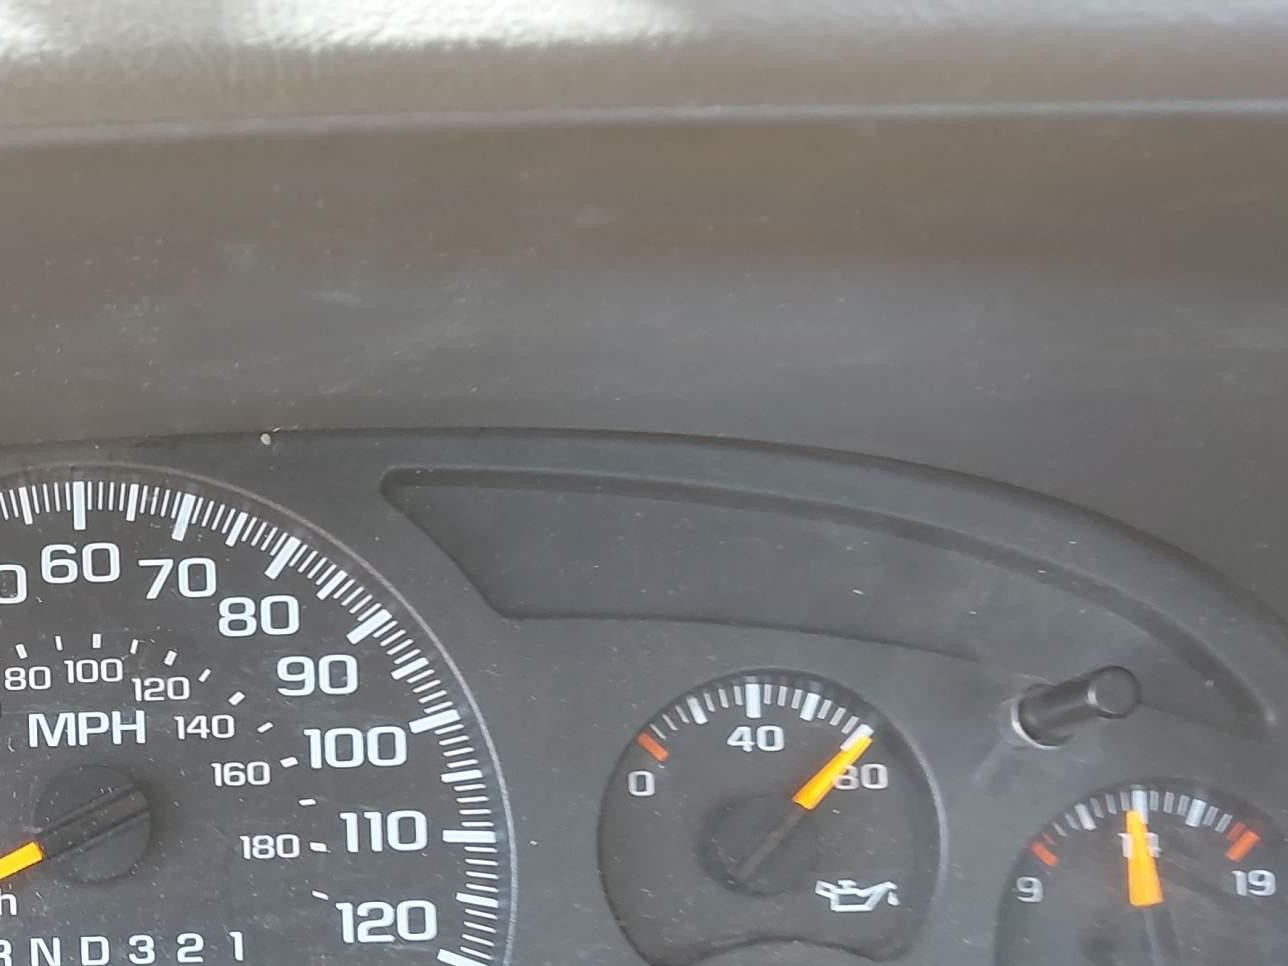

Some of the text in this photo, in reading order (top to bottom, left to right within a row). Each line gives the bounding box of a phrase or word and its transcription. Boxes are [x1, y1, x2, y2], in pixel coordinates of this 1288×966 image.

[41, 542, 121, 584] 60
[138, 557, 217, 600] 70
[218, 595, 300, 637] 80
[4, 666, 52, 691] 80
[63, 658, 123, 684] 100
[276, 654, 358, 696] 90
[131, 676, 190, 702] 120
[28, 709, 146, 748] MPH
[173, 714, 235, 740] 140
[726, 725, 785, 752] 40
[303, 726, 407, 769] 100
[210, 761, 271, 787] 160
[628, 770, 655, 797] 0
[834, 763, 888, 790] 80
[339, 810, 428, 853] 110
[239, 833, 300, 860] 180
[1117, 832, 1162, 859] 1
[1017, 876, 1044, 903] 9
[1231, 869, 1276, 897] 19
[335, 900, 437, 944] 120
[80, 935, 110, 966] D
[128, 934, 156, 965] 3
[177, 932, 204, 963] 2
[229, 931, 244, 961] 1
